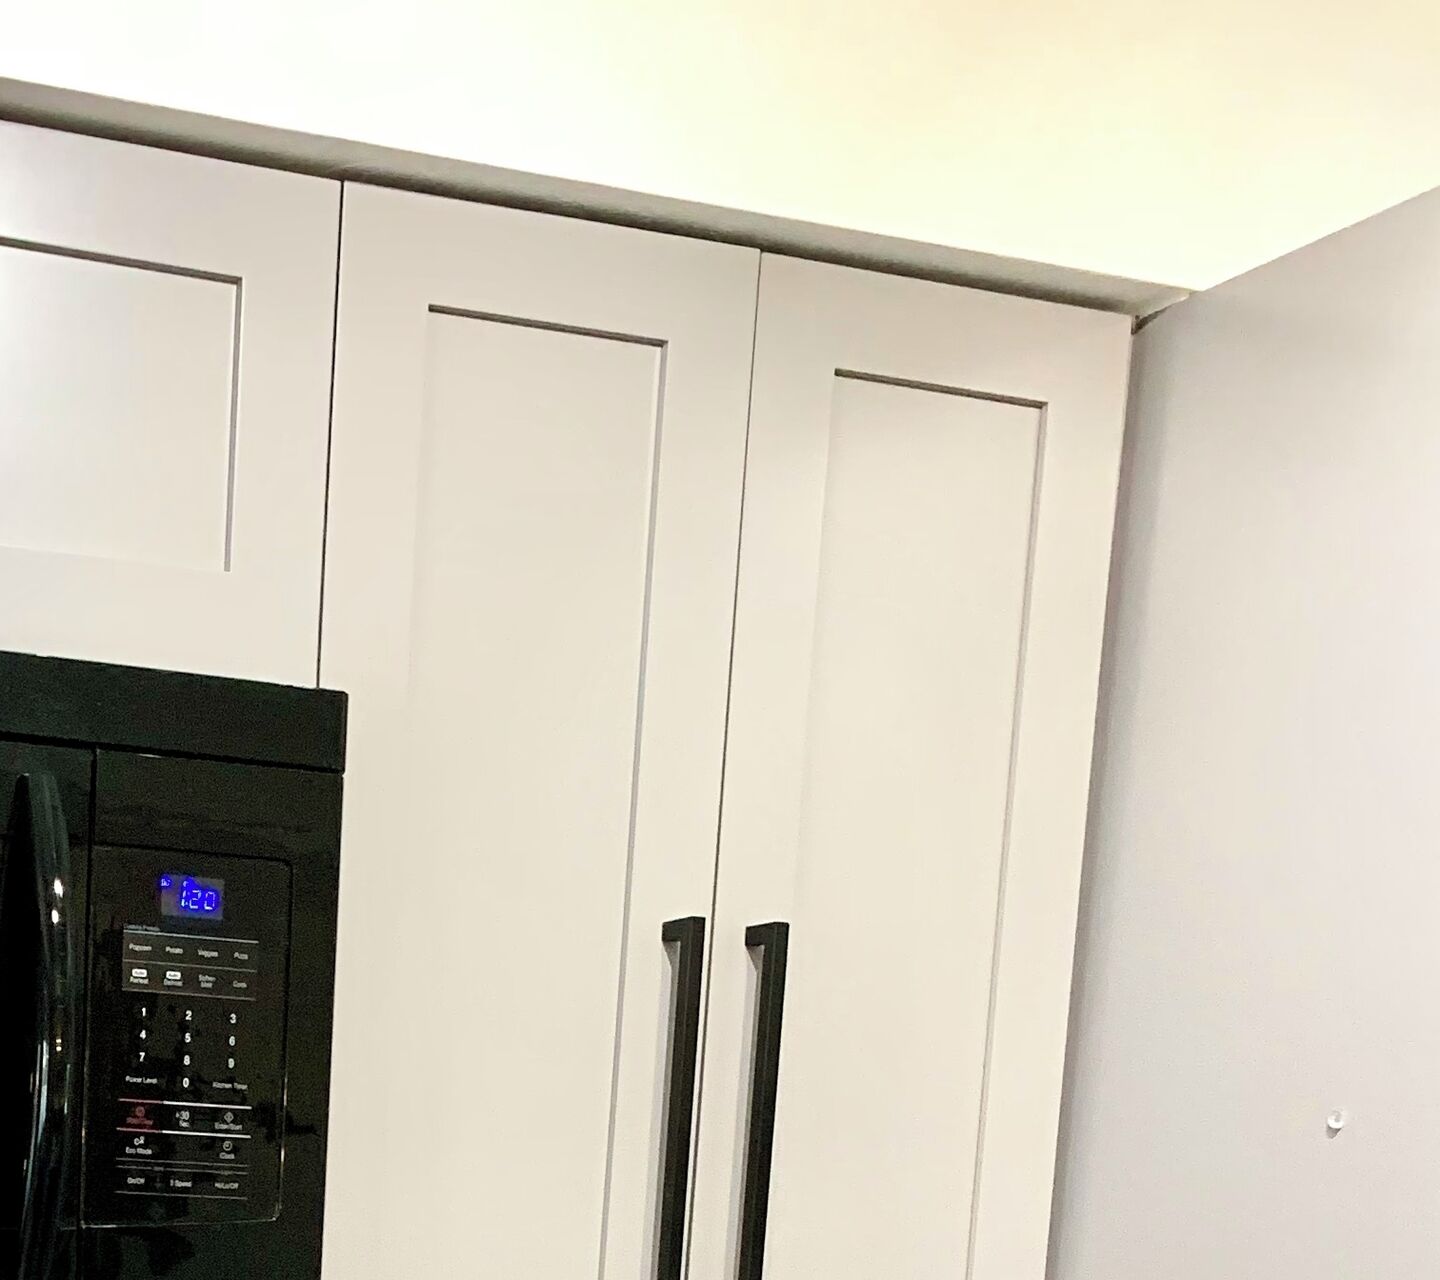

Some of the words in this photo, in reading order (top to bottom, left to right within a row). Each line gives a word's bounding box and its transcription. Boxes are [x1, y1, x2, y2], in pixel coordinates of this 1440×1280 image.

[141, 1007, 146, 1017] 1
[185, 1010, 192, 1020] 2
[229, 1013, 237, 1024] 3
[139, 1029, 146, 1039] 4
[184, 1032, 191, 1043] 5
[228, 1036, 236, 1046] 6
[139, 1052, 146, 1062] 7
[183, 1055, 191, 1065] 8
[227, 1058, 235, 1068] 9
[182, 1077, 190, 1088] 0
